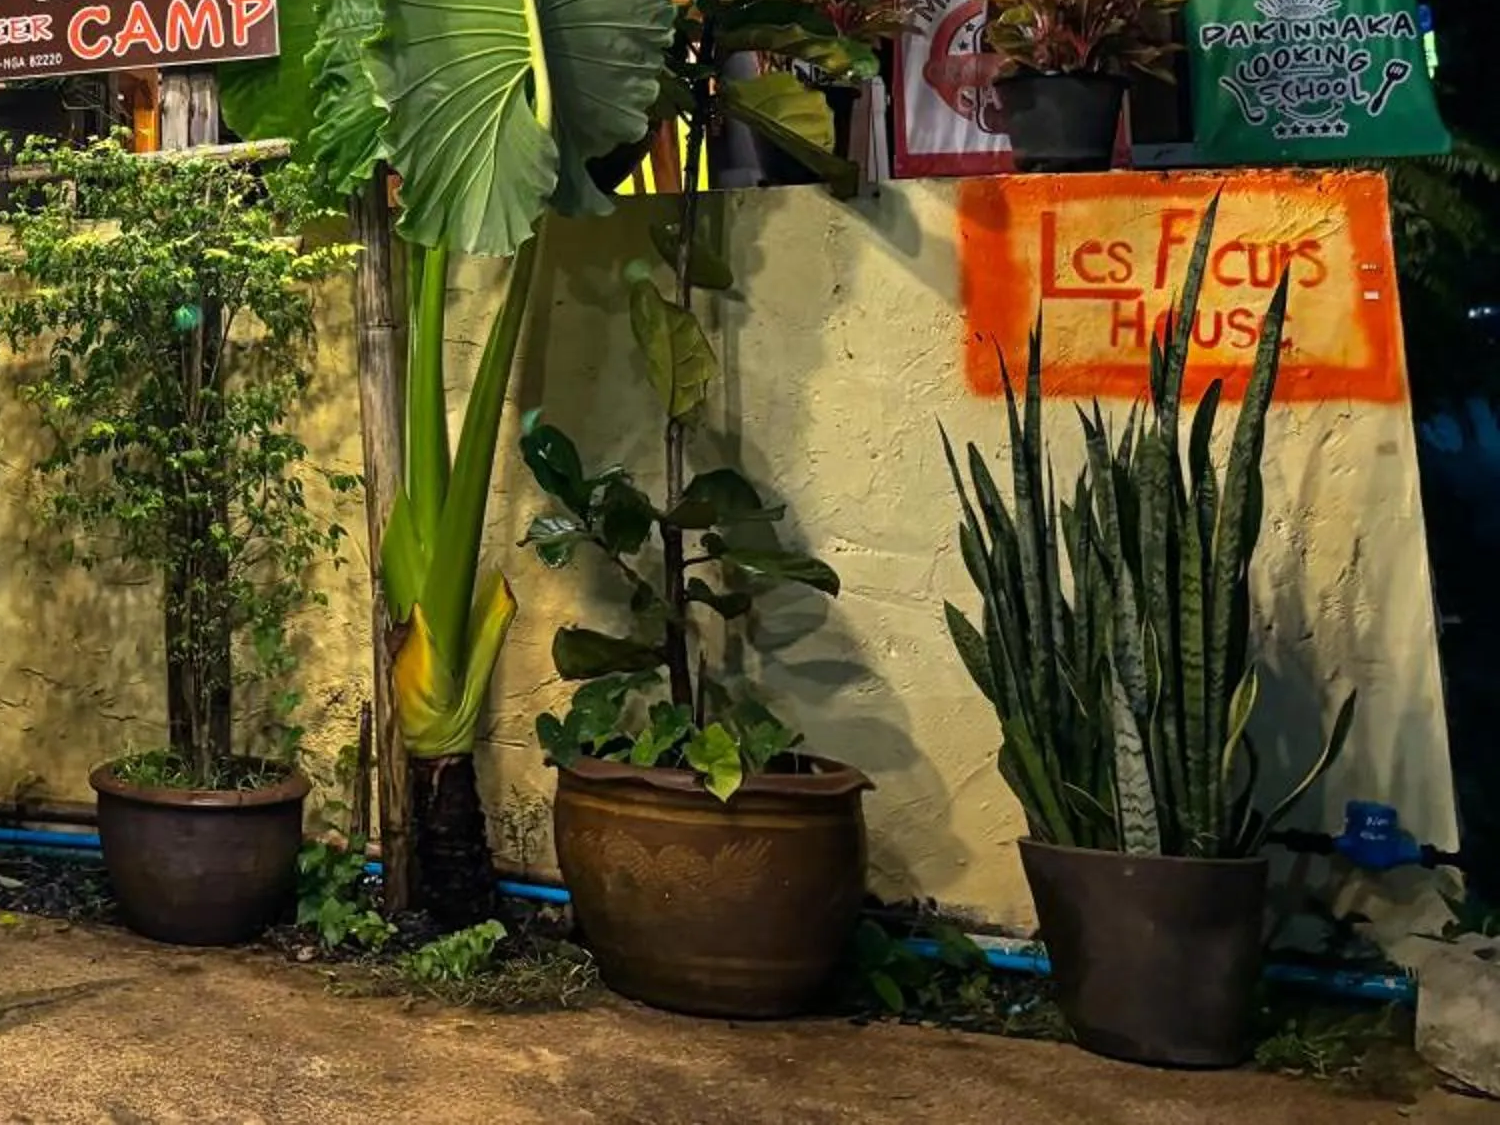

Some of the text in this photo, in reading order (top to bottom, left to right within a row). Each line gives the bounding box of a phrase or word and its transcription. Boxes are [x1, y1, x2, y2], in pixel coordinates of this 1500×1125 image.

[1200, 10, 1417, 51] PAKINNAKA
[29, 52, 63, 68] 82220
[1236, 43, 1371, 86] COOKING
[1257, 74, 1371, 108] SCHOOL
[1154, 208, 1328, 289] Fcus
